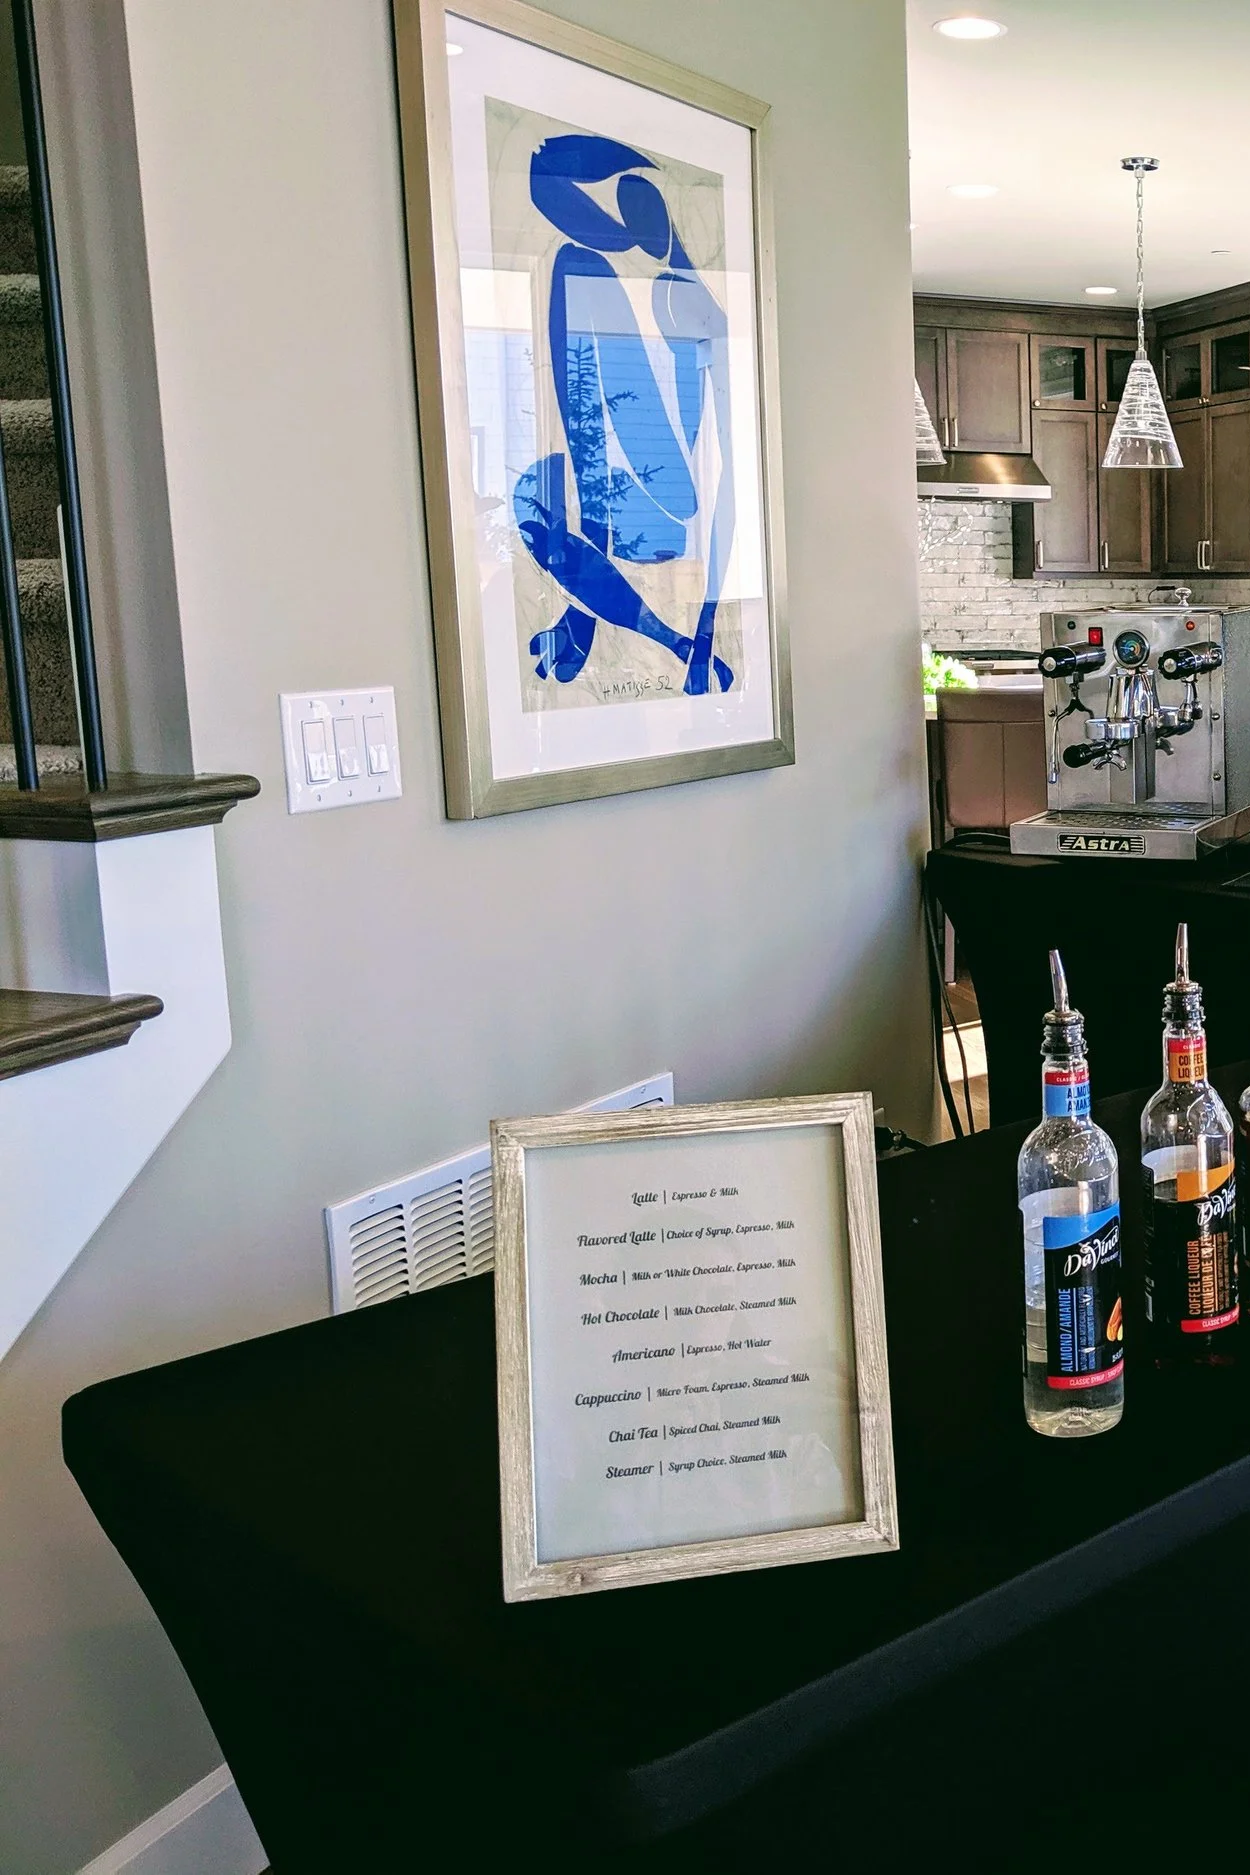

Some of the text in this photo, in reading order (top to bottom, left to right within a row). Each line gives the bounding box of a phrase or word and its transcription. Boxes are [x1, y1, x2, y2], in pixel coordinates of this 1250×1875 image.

[612, 678, 651, 699] MATISSE
[655, 675, 674, 692] 52
[631, 1192, 659, 1207] Latte
[671, 1191, 708, 1203] Espresso
[709, 1188, 717, 1198] &
[719, 1187, 739, 1197] Milk
[576, 1232, 628, 1247] Flavored
[629, 1231, 657, 1246] Latte
[666, 1229, 694, 1240] Choice
[695, 1227, 705, 1239] of
[776, 1220, 795, 1230] Milk
[579, 1273, 618, 1286] Mocha
[631, 1271, 651, 1281] Milk
[664, 1268, 691, 1278] White
[777, 1258, 796, 1268] Milk
[1187, 1239, 1201, 1316] COFFEE LIQUEUR
[1201, 1258, 1214, 1275] DE
[1201, 1276, 1214, 1315] LIQUEUR
[580, 1312, 602, 1326] Hot
[605, 1308, 660, 1323] Chocolate
[673, 1306, 694, 1316] Milk
[739, 1298, 776, 1310] Steamed
[777, 1297, 797, 1306] Milk
[1057, 1287, 1074, 1373] ALMOND/AMANDE
[612, 1347, 676, 1364] Americano
[727, 1340, 742, 1350] Hot
[744, 1338, 772, 1349] Water
[574, 1389, 642, 1408] Cappuccino
[656, 1388, 682, 1397] Micro
[752, 1375, 789, 1387] Steamed
[790, 1373, 810, 1383] Milk
[1069, 1377, 1091, 1387] CLASSIC
[608, 1428, 636, 1443] Chai
[637, 1427, 658, 1440] Tea
[668, 1424, 698, 1438] Spiced
[722, 1417, 760, 1430] Steamed
[761, 1415, 781, 1426] Milk
[605, 1465, 655, 1479] Steamer
[668, 1462, 695, 1474] Syrup
[728, 1451, 766, 1464] Steamed
[767, 1449, 787, 1460] Milk
